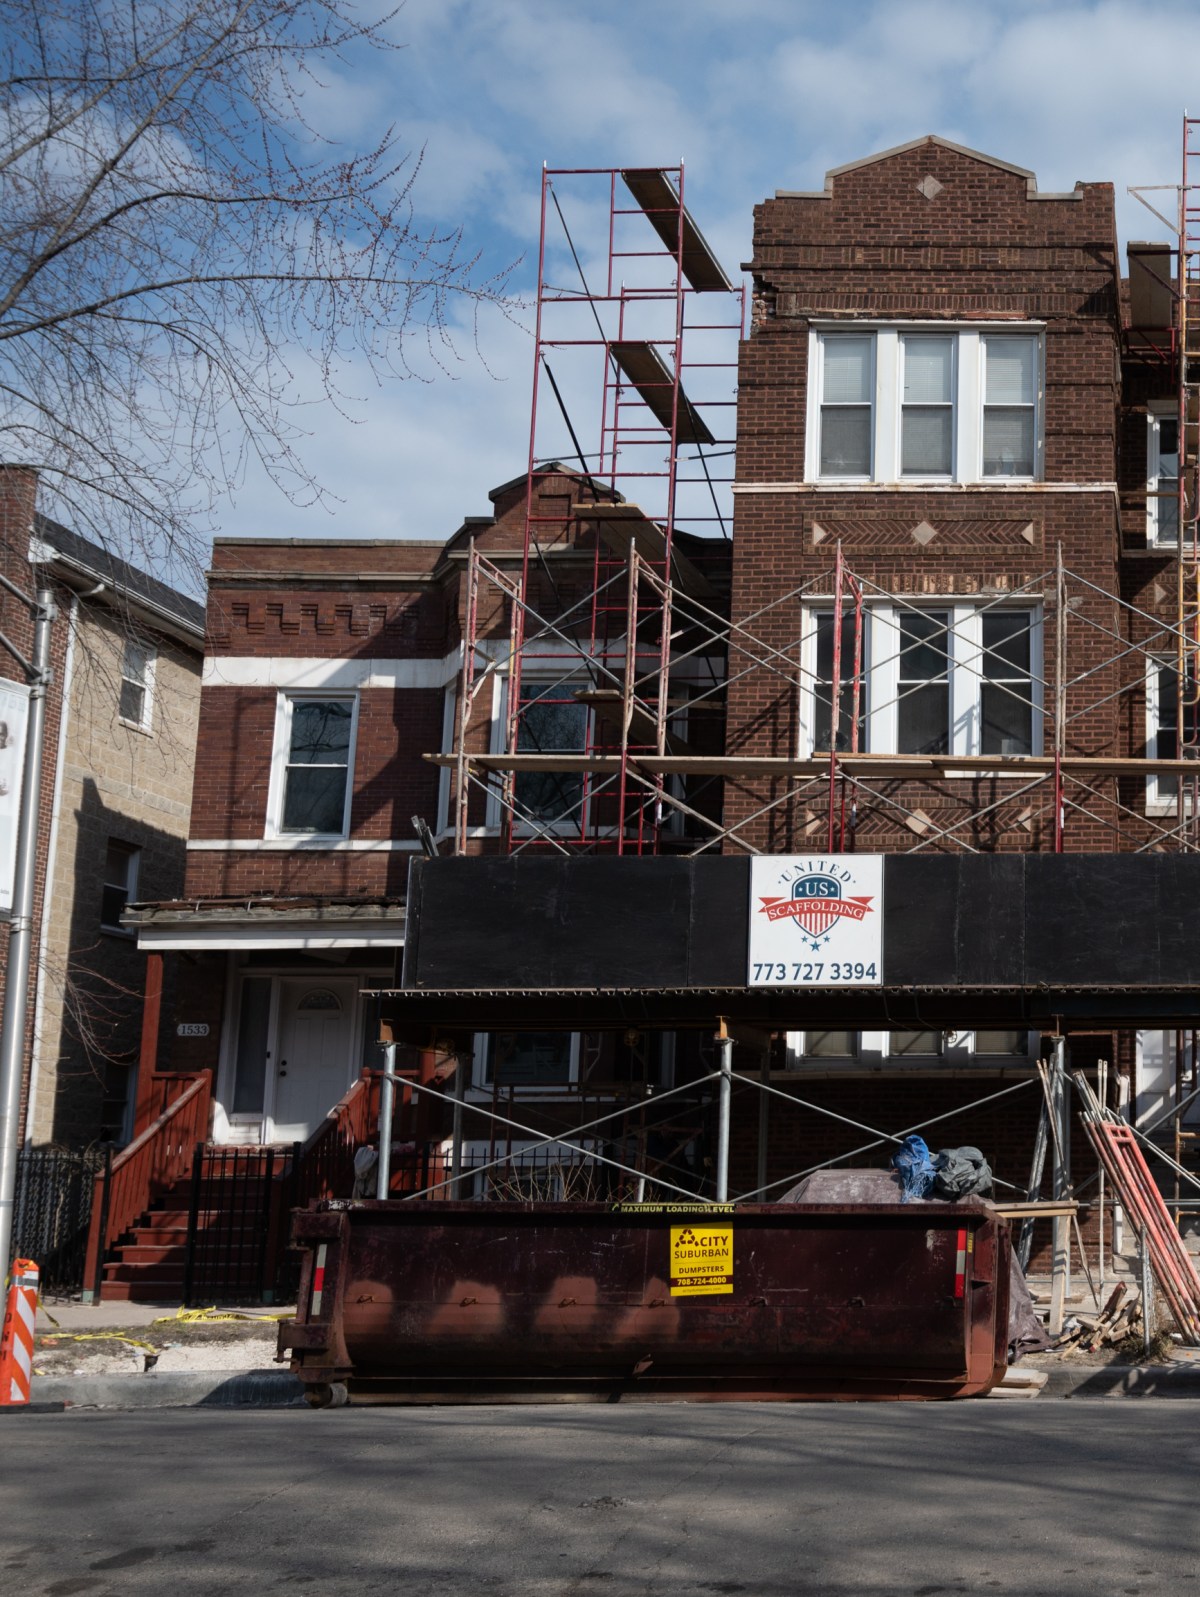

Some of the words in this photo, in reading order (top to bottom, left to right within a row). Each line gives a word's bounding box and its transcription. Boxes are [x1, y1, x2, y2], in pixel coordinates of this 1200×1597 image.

[781, 860, 852, 883] UNITED
[805, 882, 829, 896] US
[768, 901, 864, 919] SCAFFOLDING
[753, 963, 786, 981] 773
[792, 963, 824, 980] 727
[830, 962, 877, 980] 3394
[181, 1025, 208, 1035] 1533
[700, 1236, 729, 1247] CITY
[674, 1248, 729, 1259] SUBURBAN
[678, 1265, 725, 1275] DUMPSTERS
[677, 1276, 727, 1286] 708-724-4000
